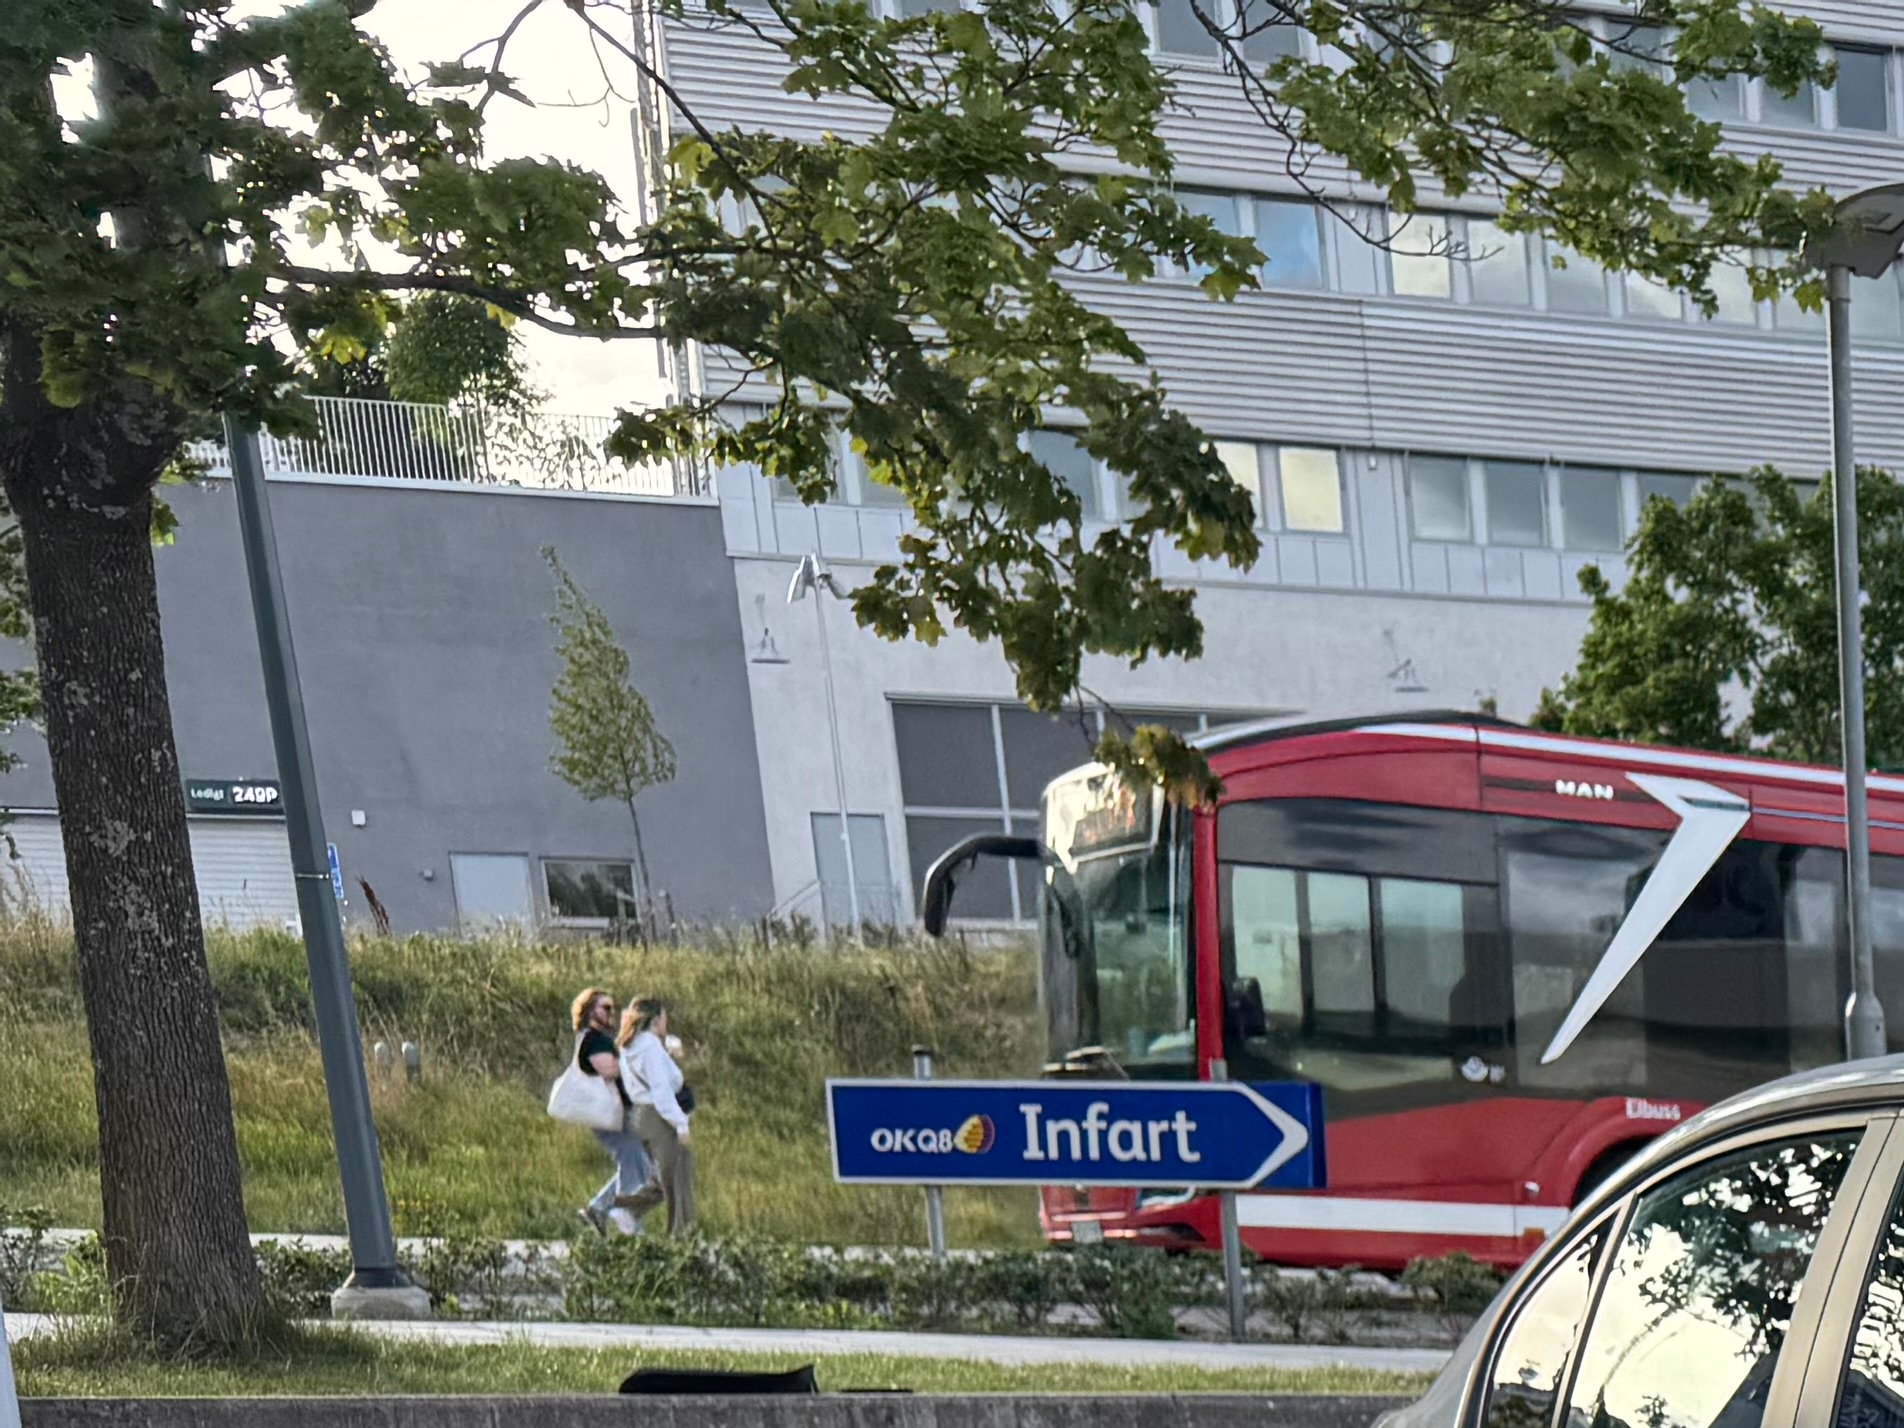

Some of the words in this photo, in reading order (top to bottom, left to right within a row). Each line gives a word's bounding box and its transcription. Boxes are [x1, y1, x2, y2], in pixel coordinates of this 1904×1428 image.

[1555, 779, 1614, 800] MAN
[870, 1127, 954, 1154] OKQ8
[1018, 1101, 1201, 1163] Infart
